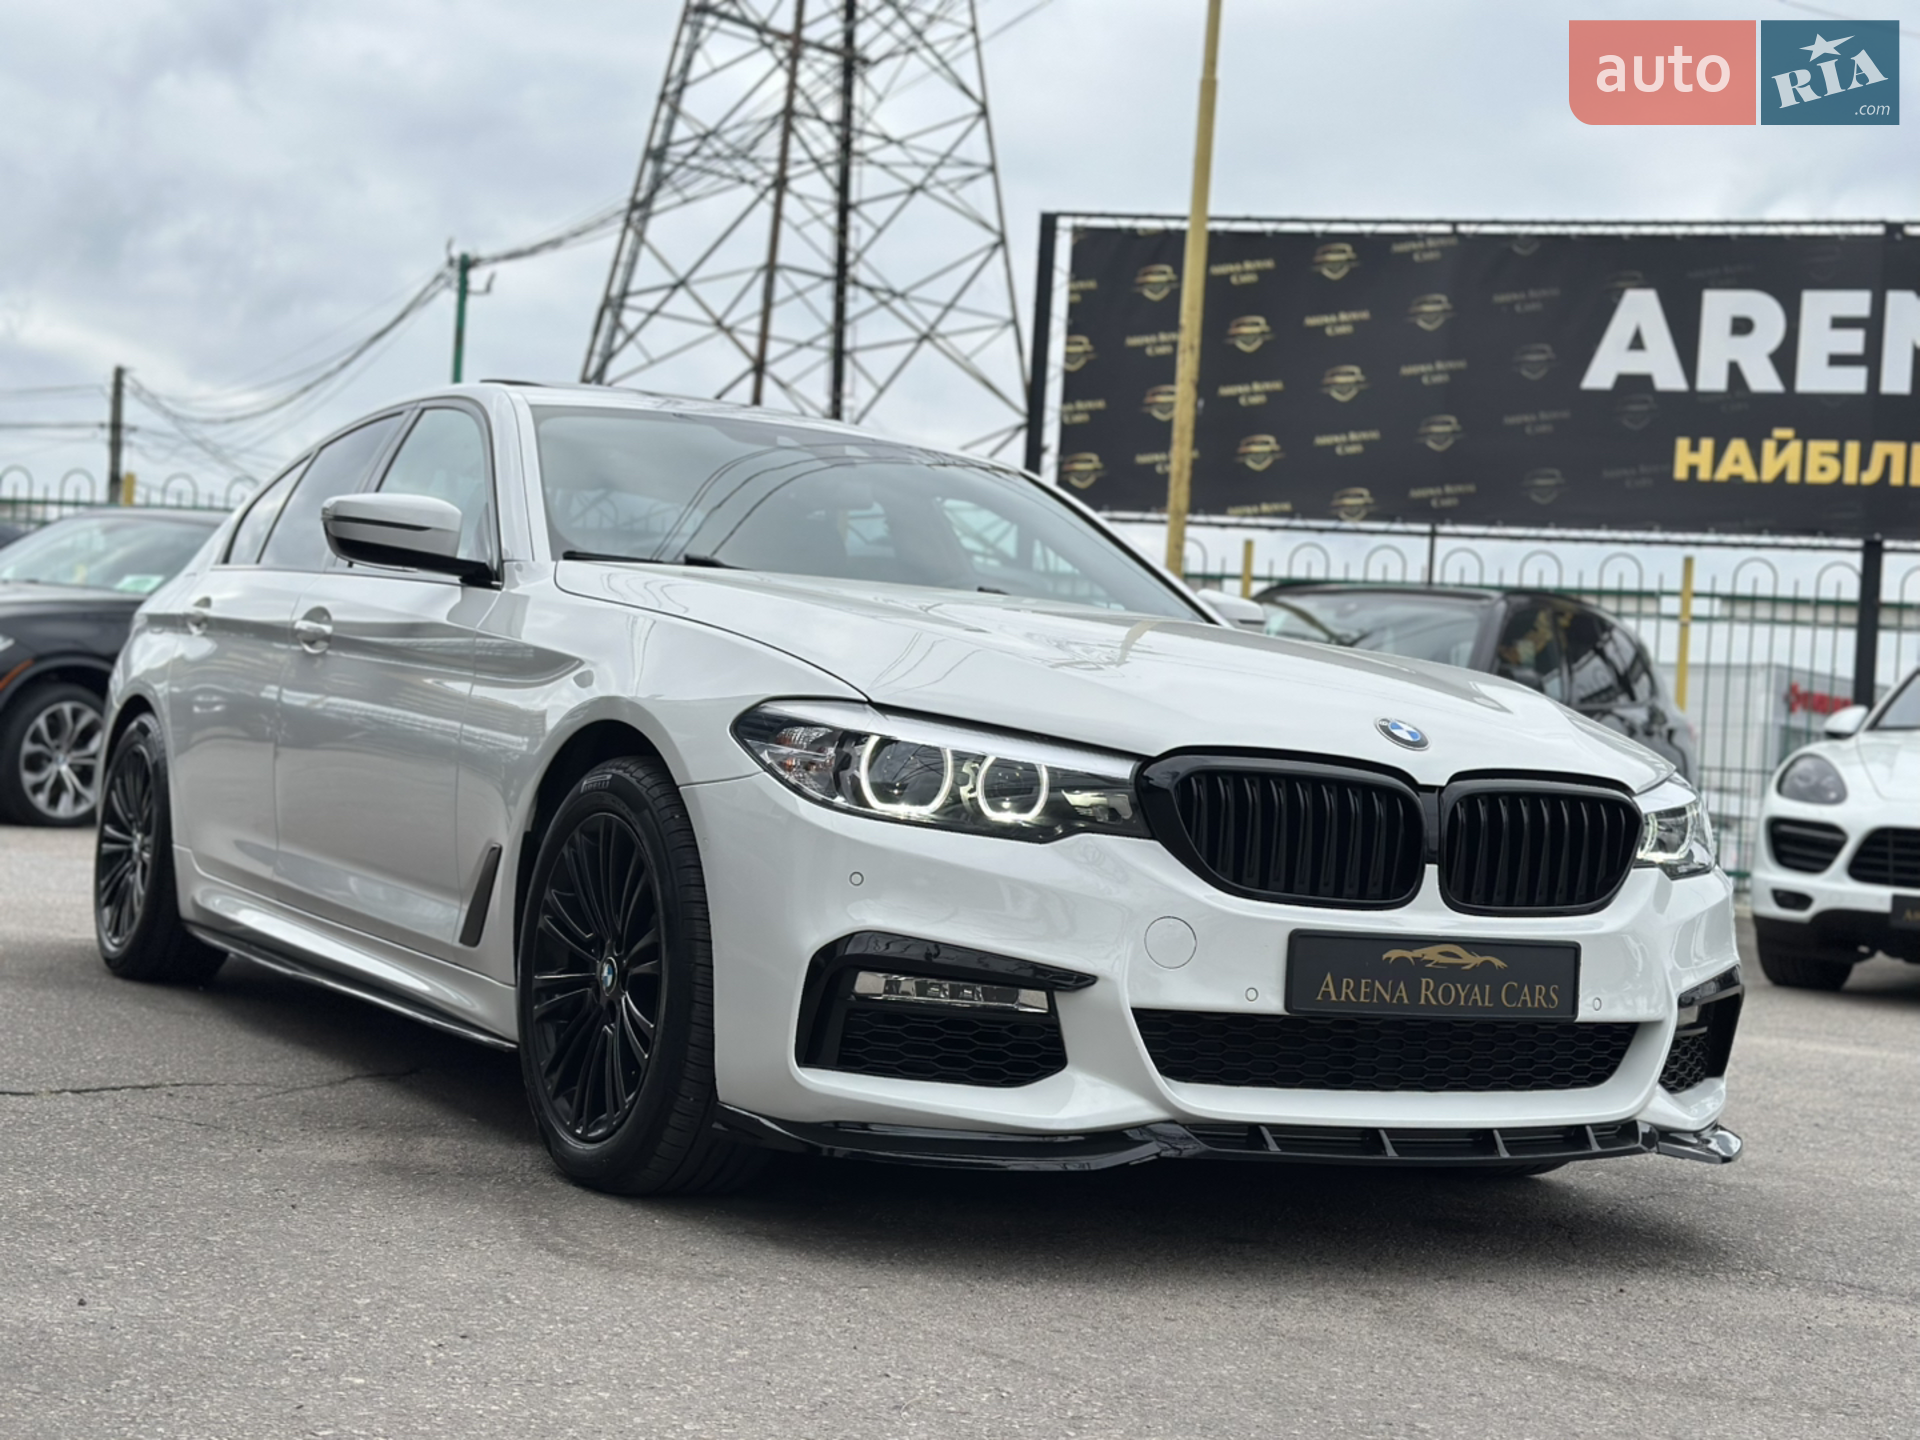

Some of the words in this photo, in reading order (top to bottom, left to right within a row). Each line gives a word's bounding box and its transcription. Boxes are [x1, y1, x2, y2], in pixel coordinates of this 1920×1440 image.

[1316, 972, 1410, 1004] ARENA
[1418, 978, 1494, 1007] ROYAL
[1501, 982, 1559, 1009] CARS
